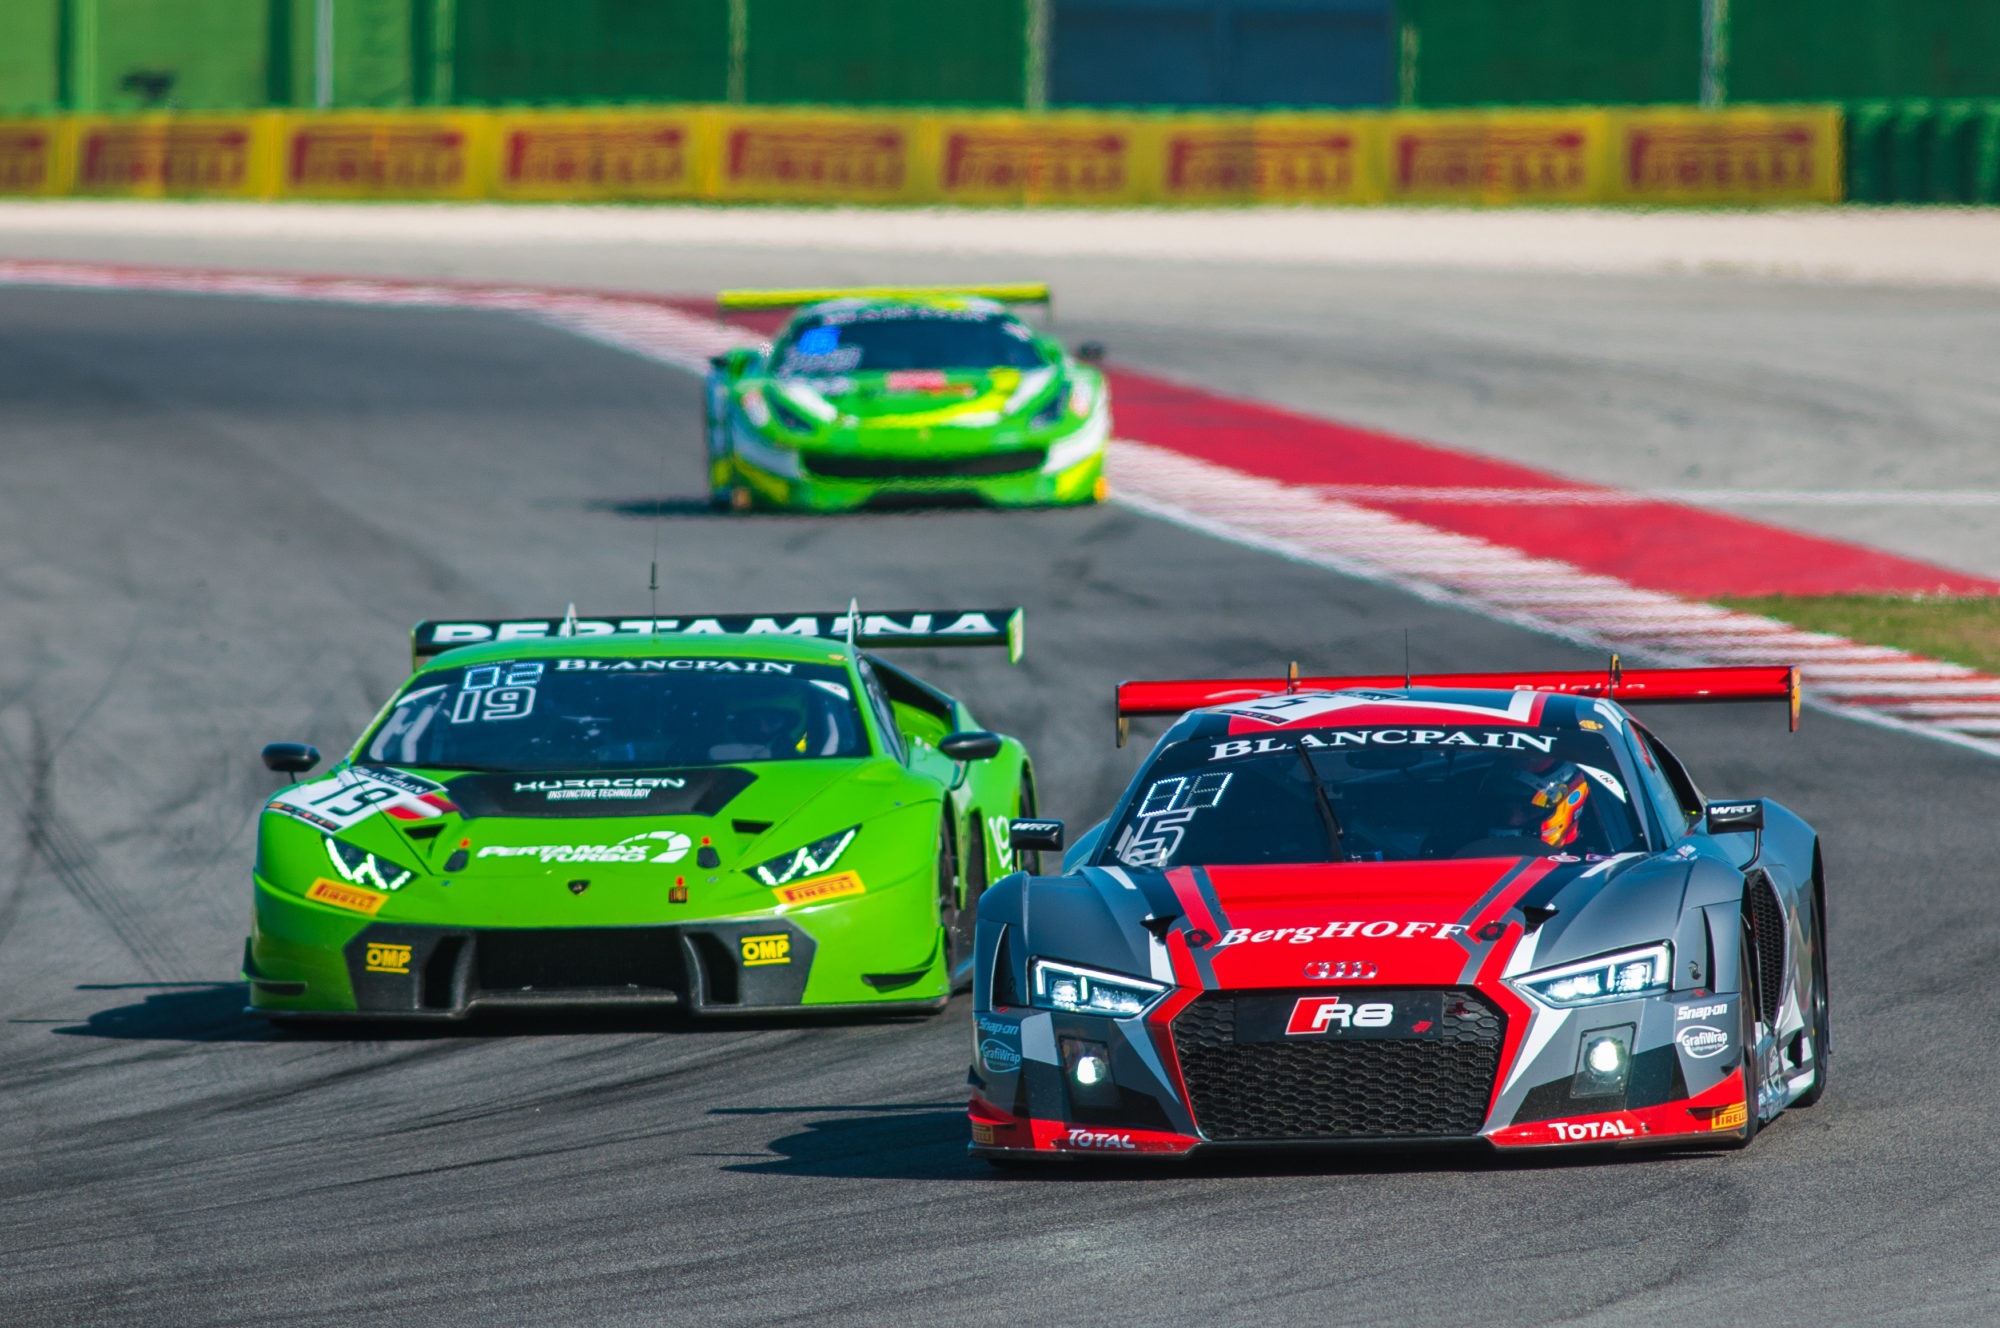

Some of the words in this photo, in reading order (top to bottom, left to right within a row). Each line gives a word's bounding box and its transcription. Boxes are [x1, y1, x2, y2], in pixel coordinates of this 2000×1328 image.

[555, 659, 796, 675] BLANCPAIN
[451, 686, 536, 723] 19
[1208, 730, 1557, 761] BLANCPAIN
[309, 779, 399, 817] 19
[547, 788, 598, 800] INSTINCTIVE
[598, 787, 652, 798] TECHNOLOGY
[1710, 804, 1757, 815] WRT
[1011, 822, 1060, 831] WRT
[784, 875, 856, 902] PIRELLI
[1215, 920, 1469, 948] BergHOFF
[366, 947, 412, 969] OMP
[741, 939, 790, 961] OMP
[1310, 1002, 1394, 1028] R8
[1677, 1003, 1728, 1021] Snap-on
[978, 1017, 1020, 1036] Snap-on
[1682, 1031, 1728, 1047] GrafiWrap
[983, 1044, 1021, 1065] GrafiWrap
[1068, 1128, 1136, 1149] TOTAL
[1547, 1119, 1635, 1140] TOTAL
